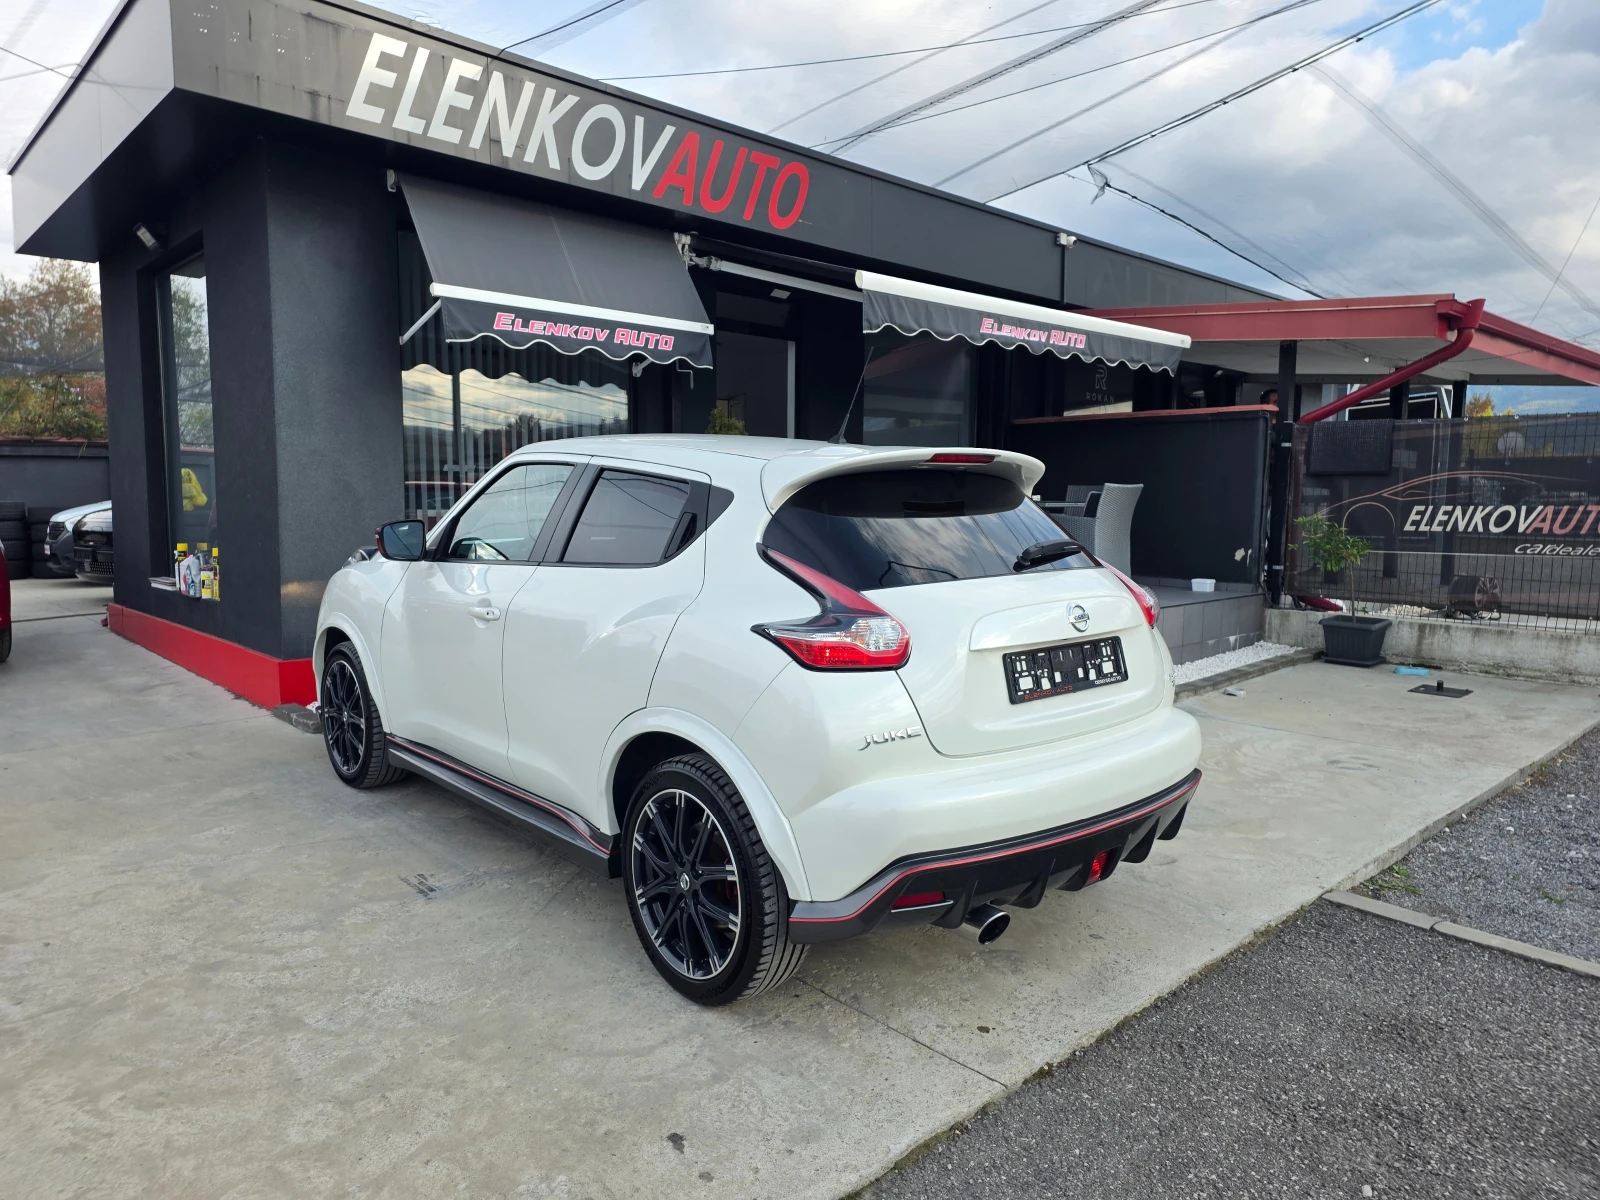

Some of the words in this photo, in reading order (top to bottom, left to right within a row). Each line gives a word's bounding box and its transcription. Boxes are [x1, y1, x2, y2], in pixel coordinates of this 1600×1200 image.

[345, 32, 810, 230] ELENKOVAUTO
[493, 312, 610, 342] ELENKOV
[614, 328, 675, 351] AUTO
[980, 317, 1049, 343] ELENKOV
[1050, 329, 1087, 349] AUTO
[1403, 504, 1600, 535] ELENKOVAUT
[1514, 543, 1600, 556] cardeale
[857, 726, 922, 751] JUKE
